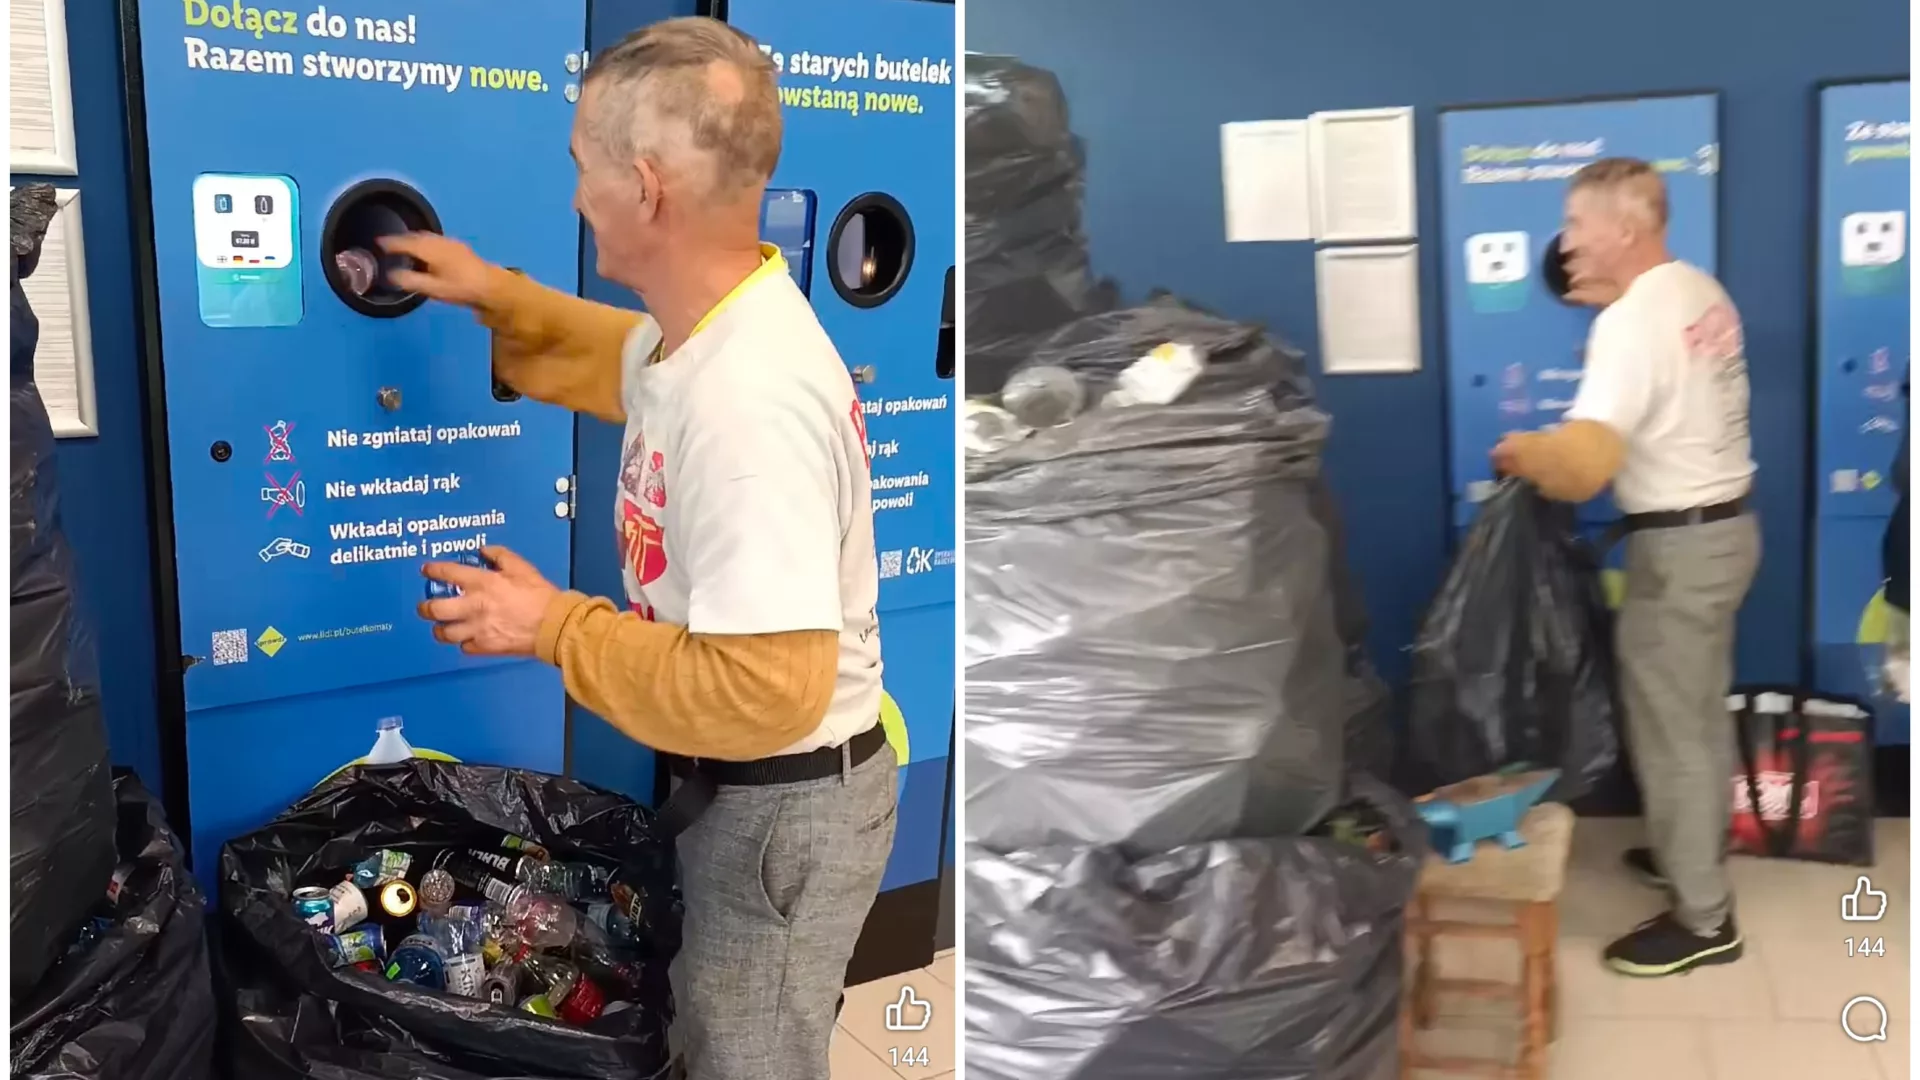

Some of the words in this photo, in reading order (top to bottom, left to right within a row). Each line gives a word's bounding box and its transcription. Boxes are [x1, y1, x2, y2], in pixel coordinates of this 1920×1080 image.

[183, 0, 298, 39] Dołącz
[306, 5, 347, 38] do
[354, 14, 416, 44] nas!
[184, 37, 293, 74] Razem
[303, 51, 463, 93] stworzymy
[470, 66, 549, 92] nowe.
[790, 51, 869, 83] starych
[875, 53, 952, 84] butelek
[778, 85, 859, 117] wstaną
[864, 91, 924, 114] nowe.
[885, 394, 948, 416] opakowań
[327, 429, 357, 447] Nie
[362, 424, 432, 449] zgniataj
[436, 420, 521, 444] opakowań
[879, 439, 900, 458] rąk
[325, 481, 356, 499] Nie
[360, 474, 429, 495] wkładaj
[433, 473, 461, 493] rąk
[869, 471, 929, 490] akowania
[872, 492, 914, 513] powoli
[330, 517, 402, 540] Wkładaj
[406, 509, 506, 536] opakowania
[330, 541, 417, 565] delikatnie
[421, 539, 427, 555] i
[431, 533, 487, 558] powoli
